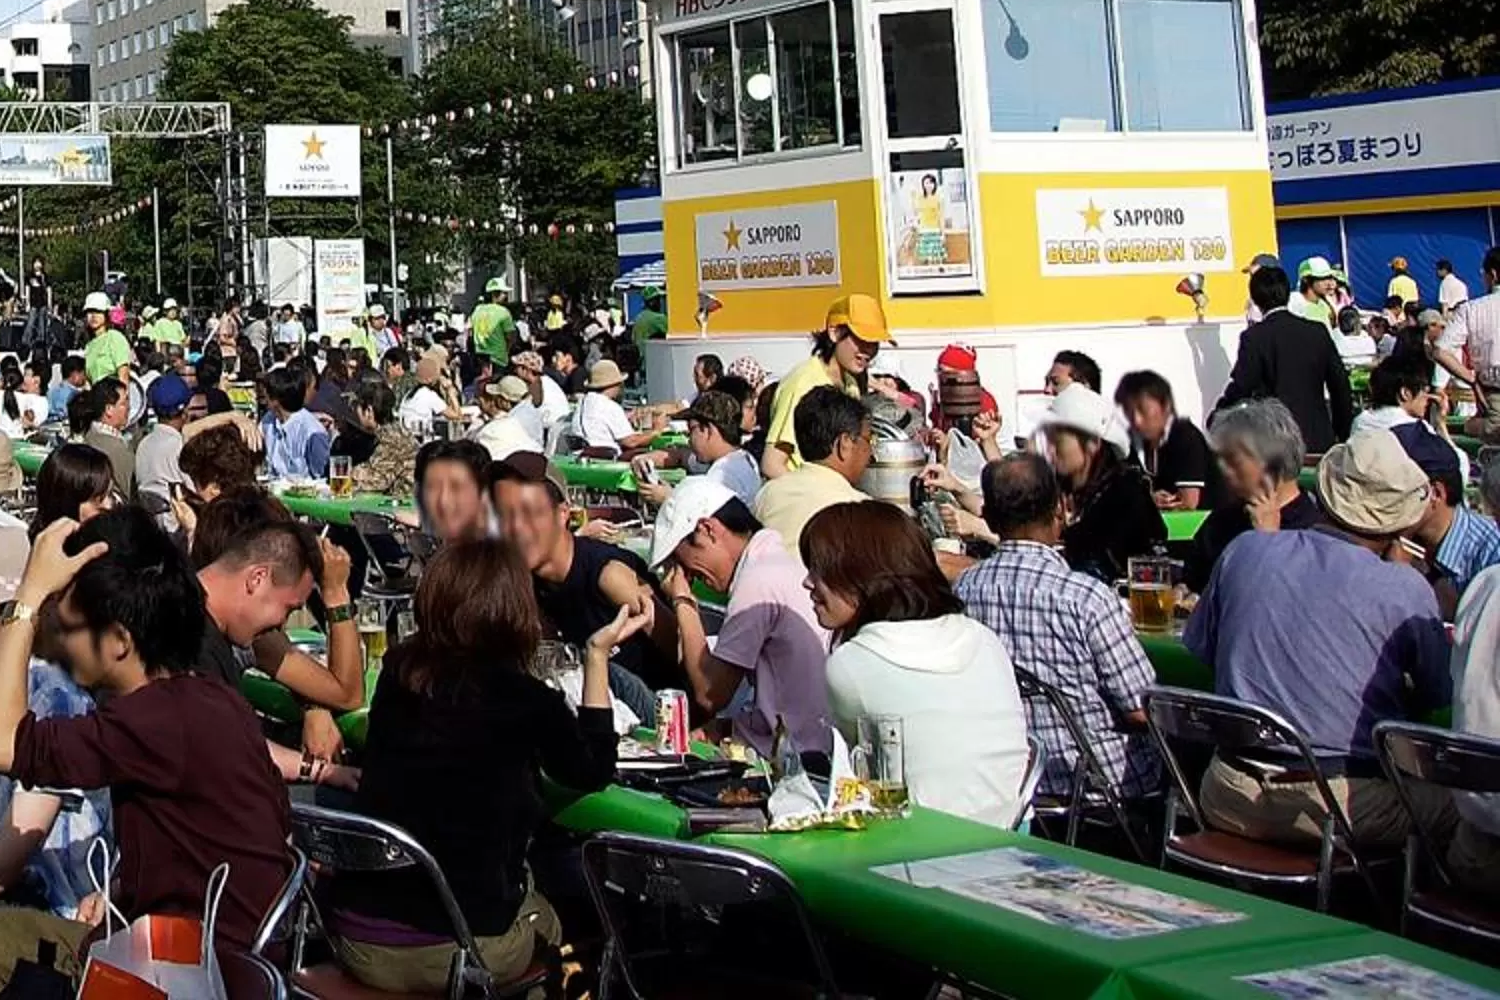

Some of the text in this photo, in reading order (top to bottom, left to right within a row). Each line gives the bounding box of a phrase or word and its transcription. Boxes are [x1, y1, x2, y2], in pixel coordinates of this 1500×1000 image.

[1113, 208, 1185, 227] SAPPORO
[747, 224, 801, 245] SAPPORO
[1045, 235, 1227, 264] BEER GARDEN 130
[701, 250, 835, 281] BEER GARDEN 130
